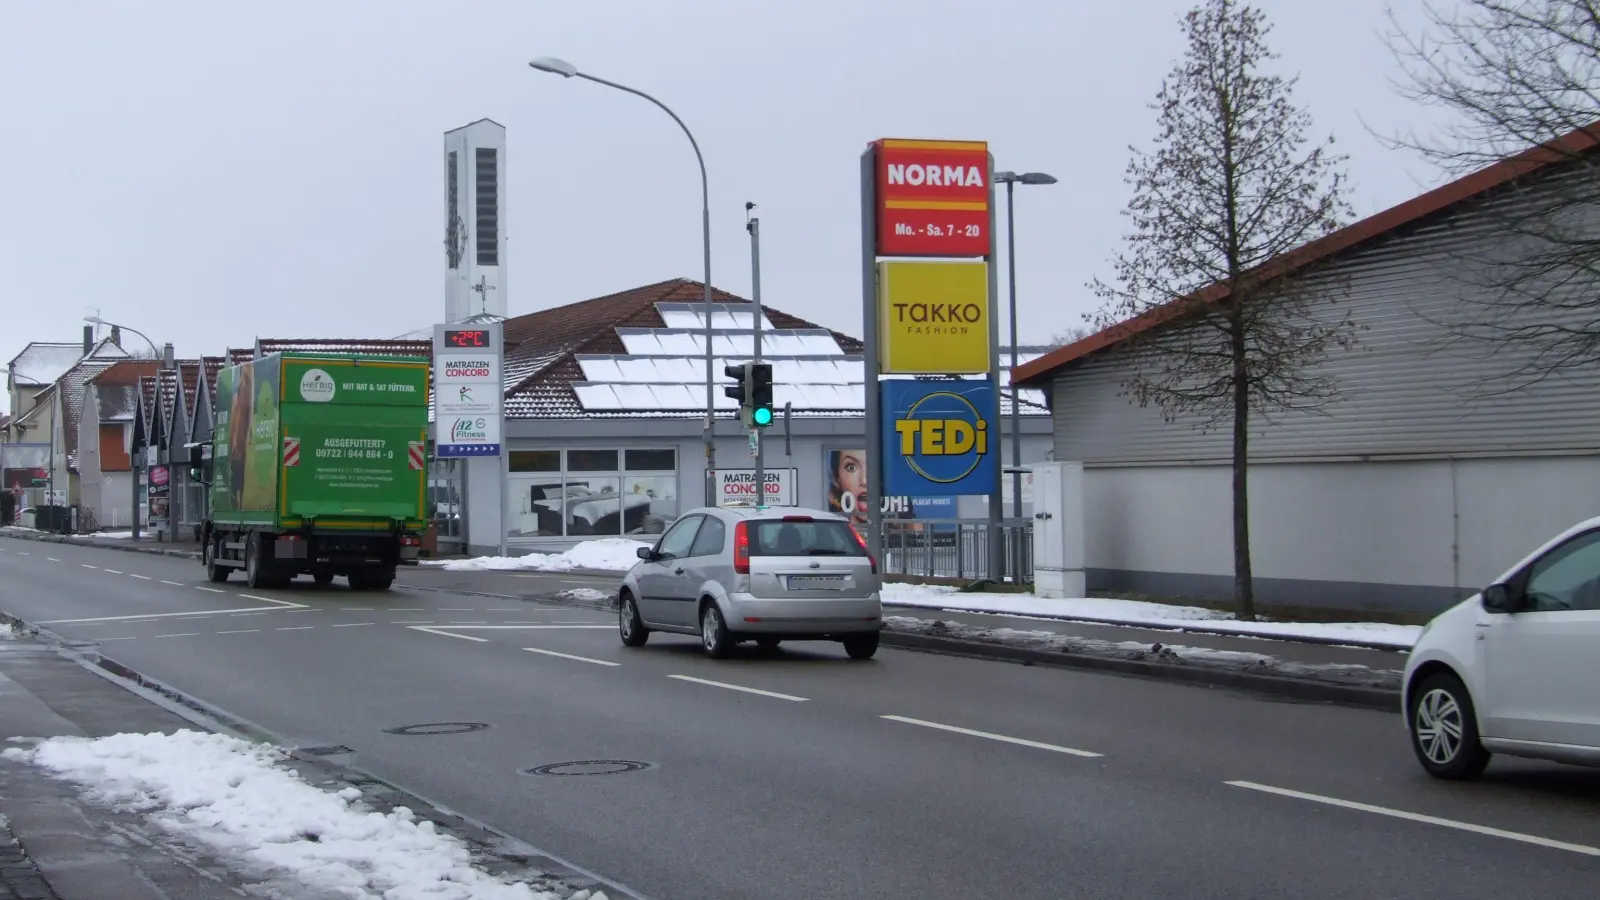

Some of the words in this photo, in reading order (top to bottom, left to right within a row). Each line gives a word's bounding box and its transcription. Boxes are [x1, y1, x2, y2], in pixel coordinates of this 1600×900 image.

[887, 163, 984, 187] NORMA
[895, 223, 916, 236] Mo.
[926, 223, 944, 237] Sa.
[946, 224, 954, 237] 7
[965, 224, 980, 237] 20
[907, 327, 968, 335] FASHION
[445, 361, 490, 369] MATRATZEN
[445, 369, 490, 378] CONCORD
[342, 382, 354, 391] MIT
[356, 382, 368, 392] RAT
[369, 384, 375, 392] &
[376, 383, 387, 392] TAT
[456, 430, 486, 438] Fitness
[895, 419, 988, 456] TEDi
[315, 448, 342, 458] 09722
[348, 450, 363, 459] 944
[388, 450, 394, 459] 0
[723, 473, 780, 483] MATRAZEN
[723, 483, 780, 495] CONCRD
